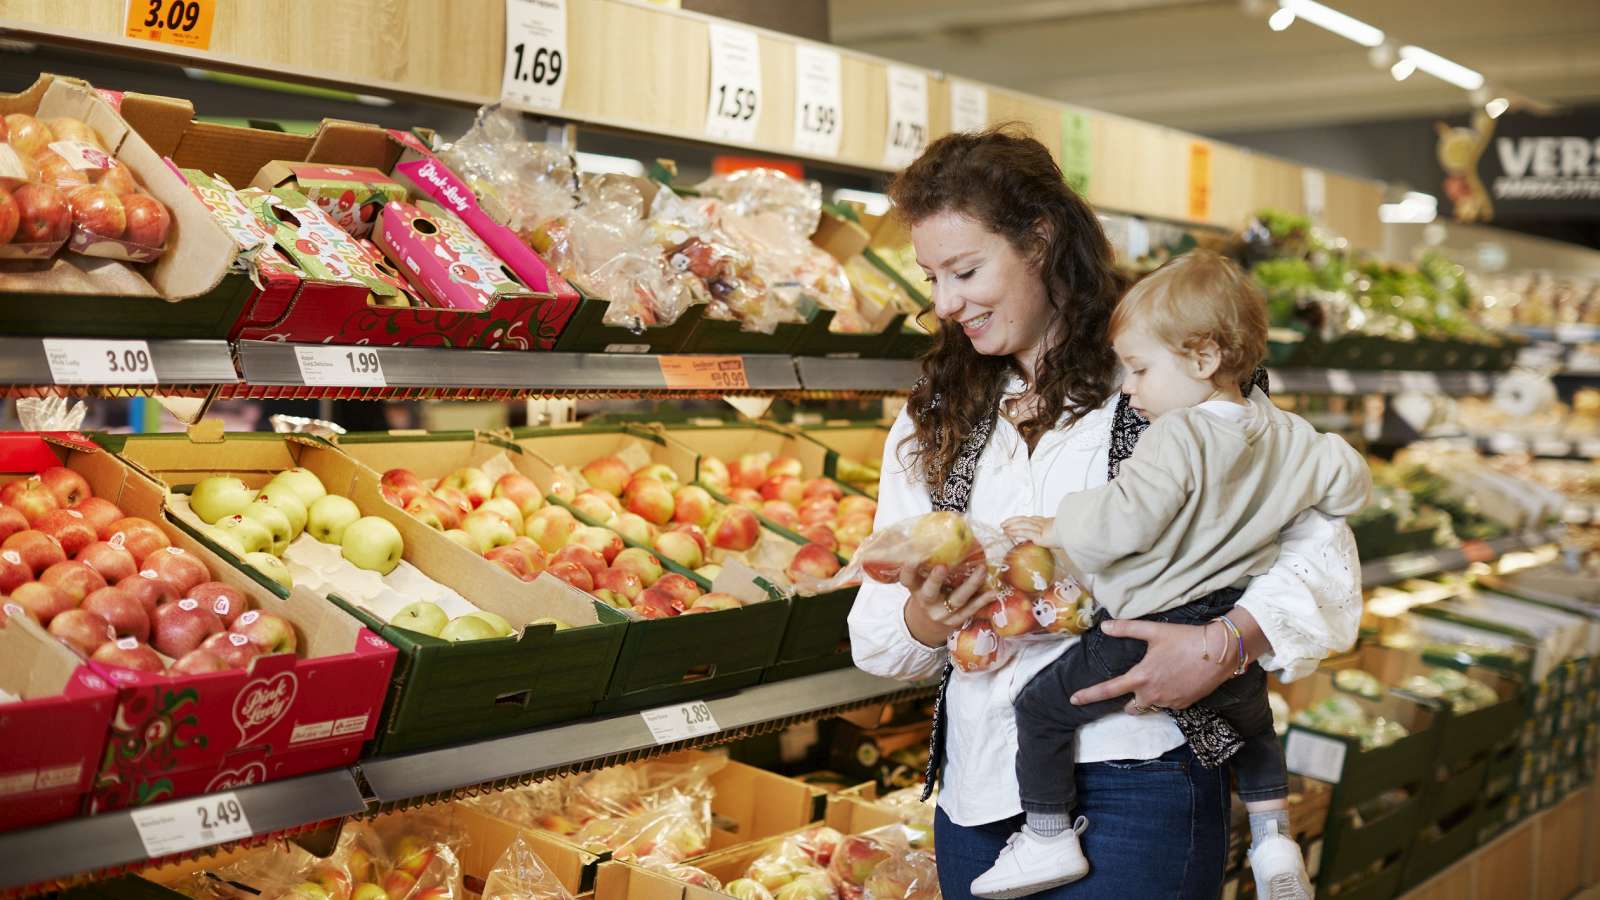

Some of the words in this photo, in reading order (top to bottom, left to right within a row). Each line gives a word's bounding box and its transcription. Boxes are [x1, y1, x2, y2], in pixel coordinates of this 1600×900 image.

[144, 0, 200, 32] 3.09
[514, 43, 562, 86] 1.69
[717, 84, 757, 121] 1.59
[418, 163, 448, 188] Pink
[443, 185, 470, 211] Lady
[106, 350, 149, 372] 3.09
[346, 352, 379, 374] 1.99
[241, 679, 287, 715] Pink
[243, 698, 286, 729] Lady
[681, 704, 710, 724] 2.89
[197, 799, 241, 829] 2.49
